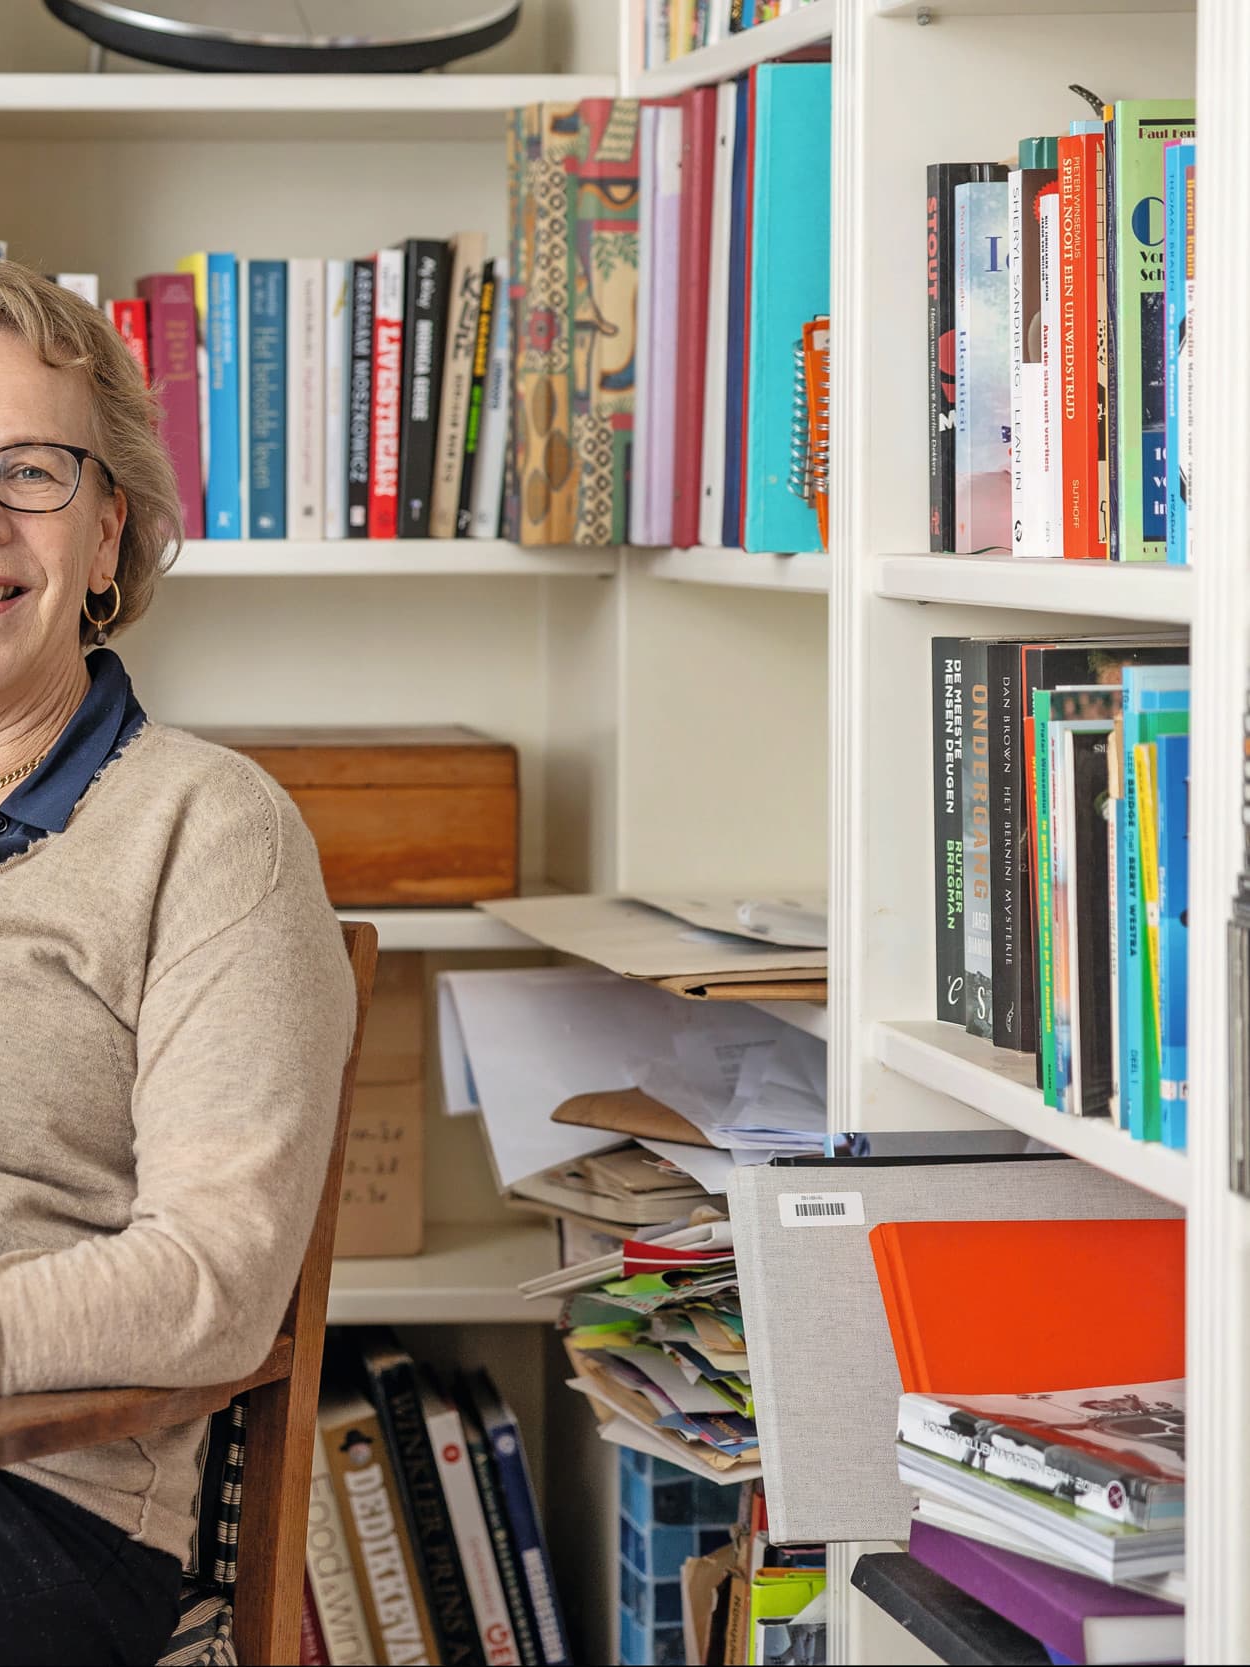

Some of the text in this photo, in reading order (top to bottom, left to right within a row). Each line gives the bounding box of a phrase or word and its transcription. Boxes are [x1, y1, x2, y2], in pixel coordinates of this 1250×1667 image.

[1138, 127, 1168, 140] Paul
[1073, 157, 1081, 258] PIETER WINSEMIUS
[927, 196, 938, 300] STOUT
[355, 266, 373, 356] ABRAHAM
[1012, 187, 1022, 387] SHERYL SANDBERG
[1062, 158, 1076, 420] SPEEL NOOIT EEN UITWEDSTRIJD
[1043, 351, 1050, 367] de
[375, 325, 403, 498] LIVESTREAM
[1015, 471, 1022, 491] IN
[953, 659, 963, 759] DE MEESTE
[1002, 677, 1011, 708] DAN
[944, 659, 955, 814] MENSEN DEUGEN
[1003, 715, 1011, 773] BROWN
[972, 684, 989, 900] ONDERGANG
[1128, 779, 1136, 828] BRIDGE
[946, 840, 955, 929] BREGMAN
[955, 840, 963, 913] RUTGER
[1004, 821, 1012, 881] BERNINI
[1129, 856, 1137, 896] BERRY
[1004, 888, 1013, 966] MYSTERIE
[1129, 905, 1138, 957] WESTRA
[922, 1419, 964, 1445] HOCKEY
